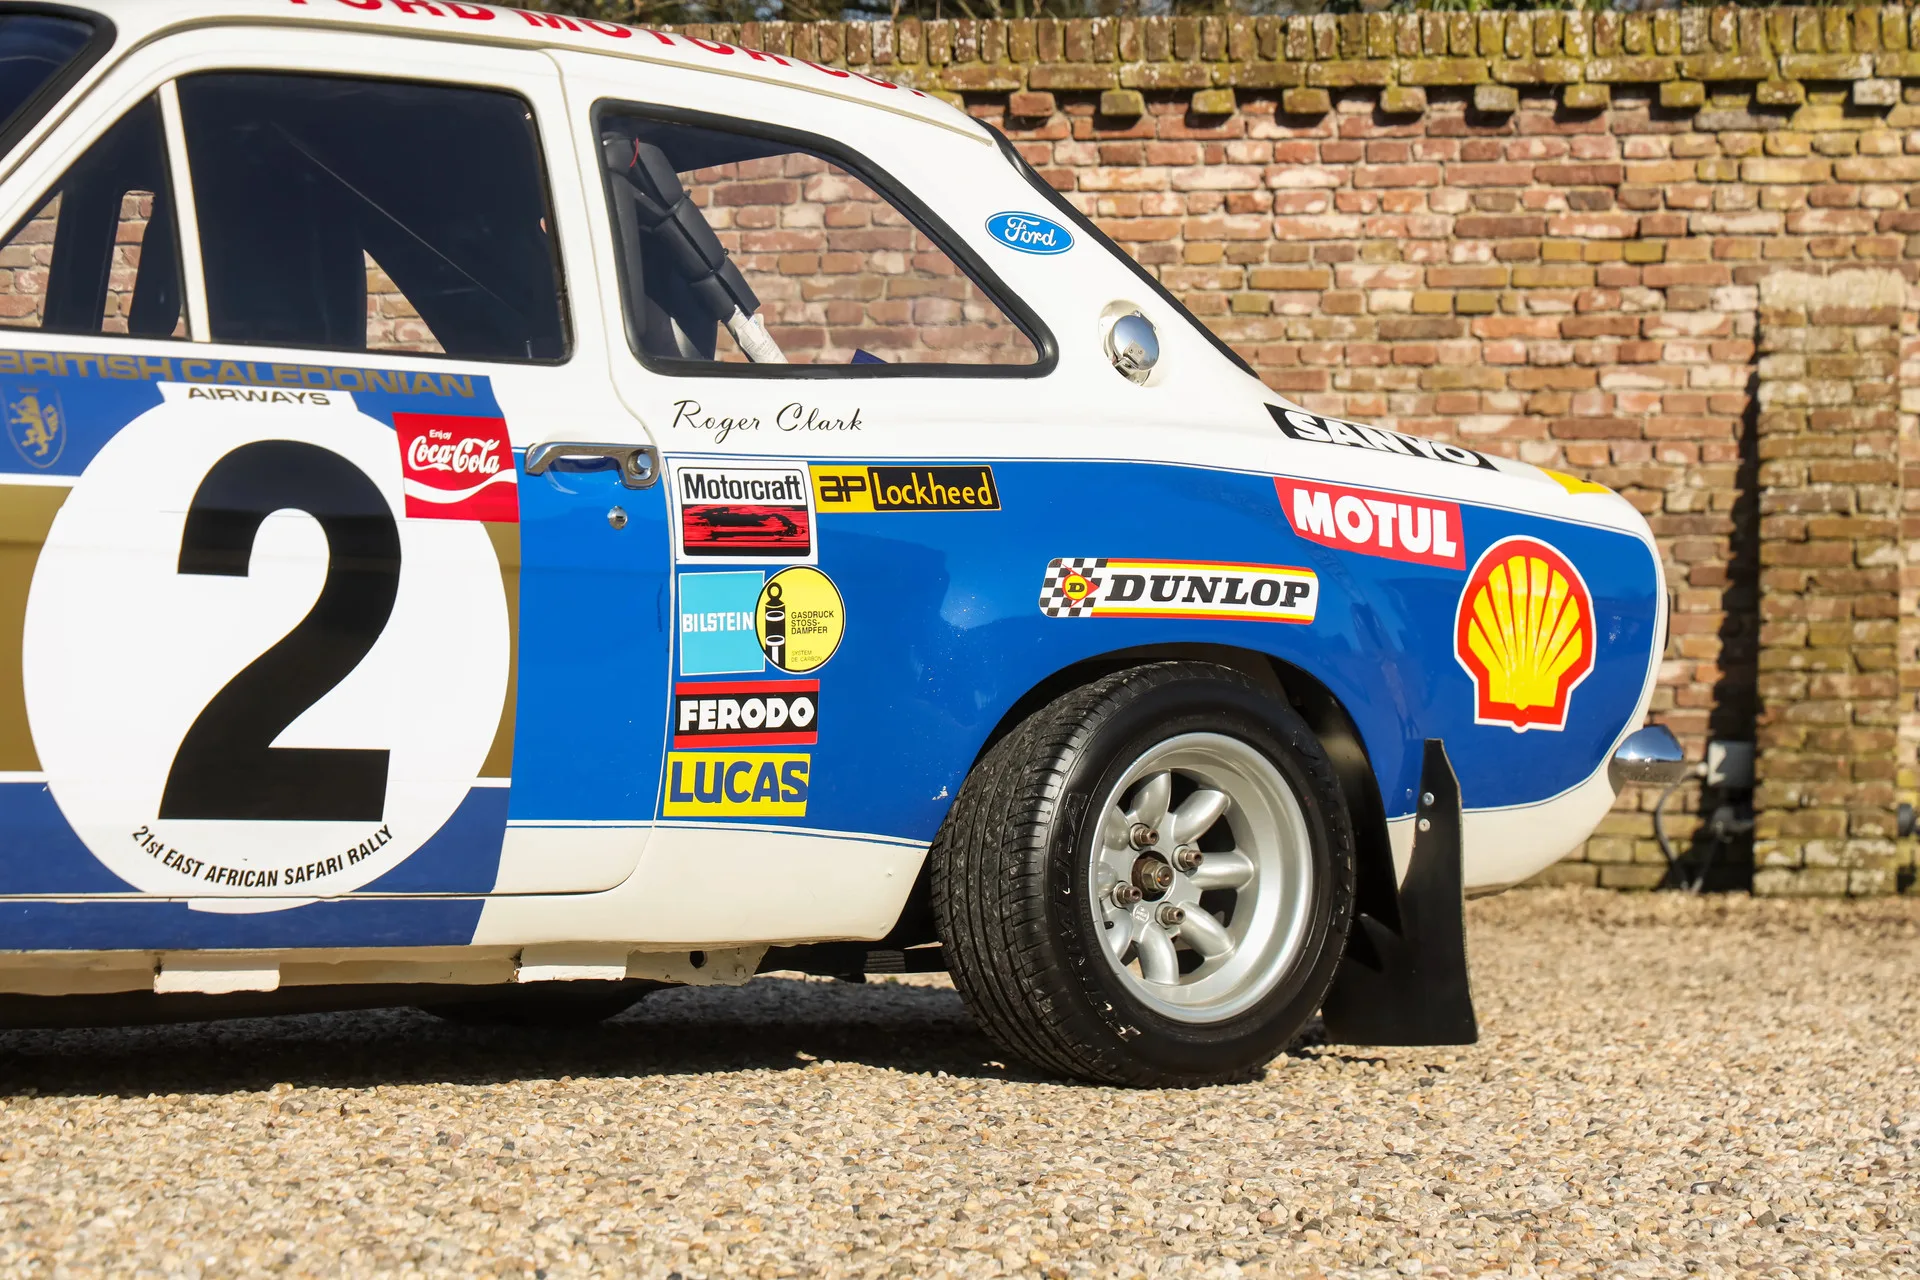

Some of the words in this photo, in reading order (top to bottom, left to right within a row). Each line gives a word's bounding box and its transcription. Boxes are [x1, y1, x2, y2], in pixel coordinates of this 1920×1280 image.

[289, 0, 496, 21] ORD
[1004, 216, 1057, 247] Ford
[0, 351, 175, 382] BRITISH
[180, 359, 476, 398] CALEDONIAN
[188, 386, 331, 406] AIRWAYS
[429, 429, 453, 440] Enjoy
[672, 399, 761, 445] Roger
[776, 402, 863, 432] Clark
[1284, 409, 1481, 467] SANYO
[407, 435, 501, 474] Coca-Cola
[683, 473, 803, 501] Motorcraft
[872, 472, 993, 506] Lockheed
[1293, 488, 1457, 558] MOTUL
[1067, 582, 1086, 593] D
[1104, 574, 1311, 608] DUNLOP
[157, 439, 402, 822] 2
[682, 611, 754, 633] BILSTEIN
[790, 610, 835, 619] GASDRUCK
[790, 619, 821, 627] STOSS-
[678, 696, 815, 731] FERODO
[669, 760, 809, 804] LUCAS
[132, 825, 165, 859] 21st
[162, 848, 205, 878] EAST
[204, 865, 279, 888] AFRICAN
[283, 853, 344, 886] SAFARI
[346, 824, 394, 866] RALLY
